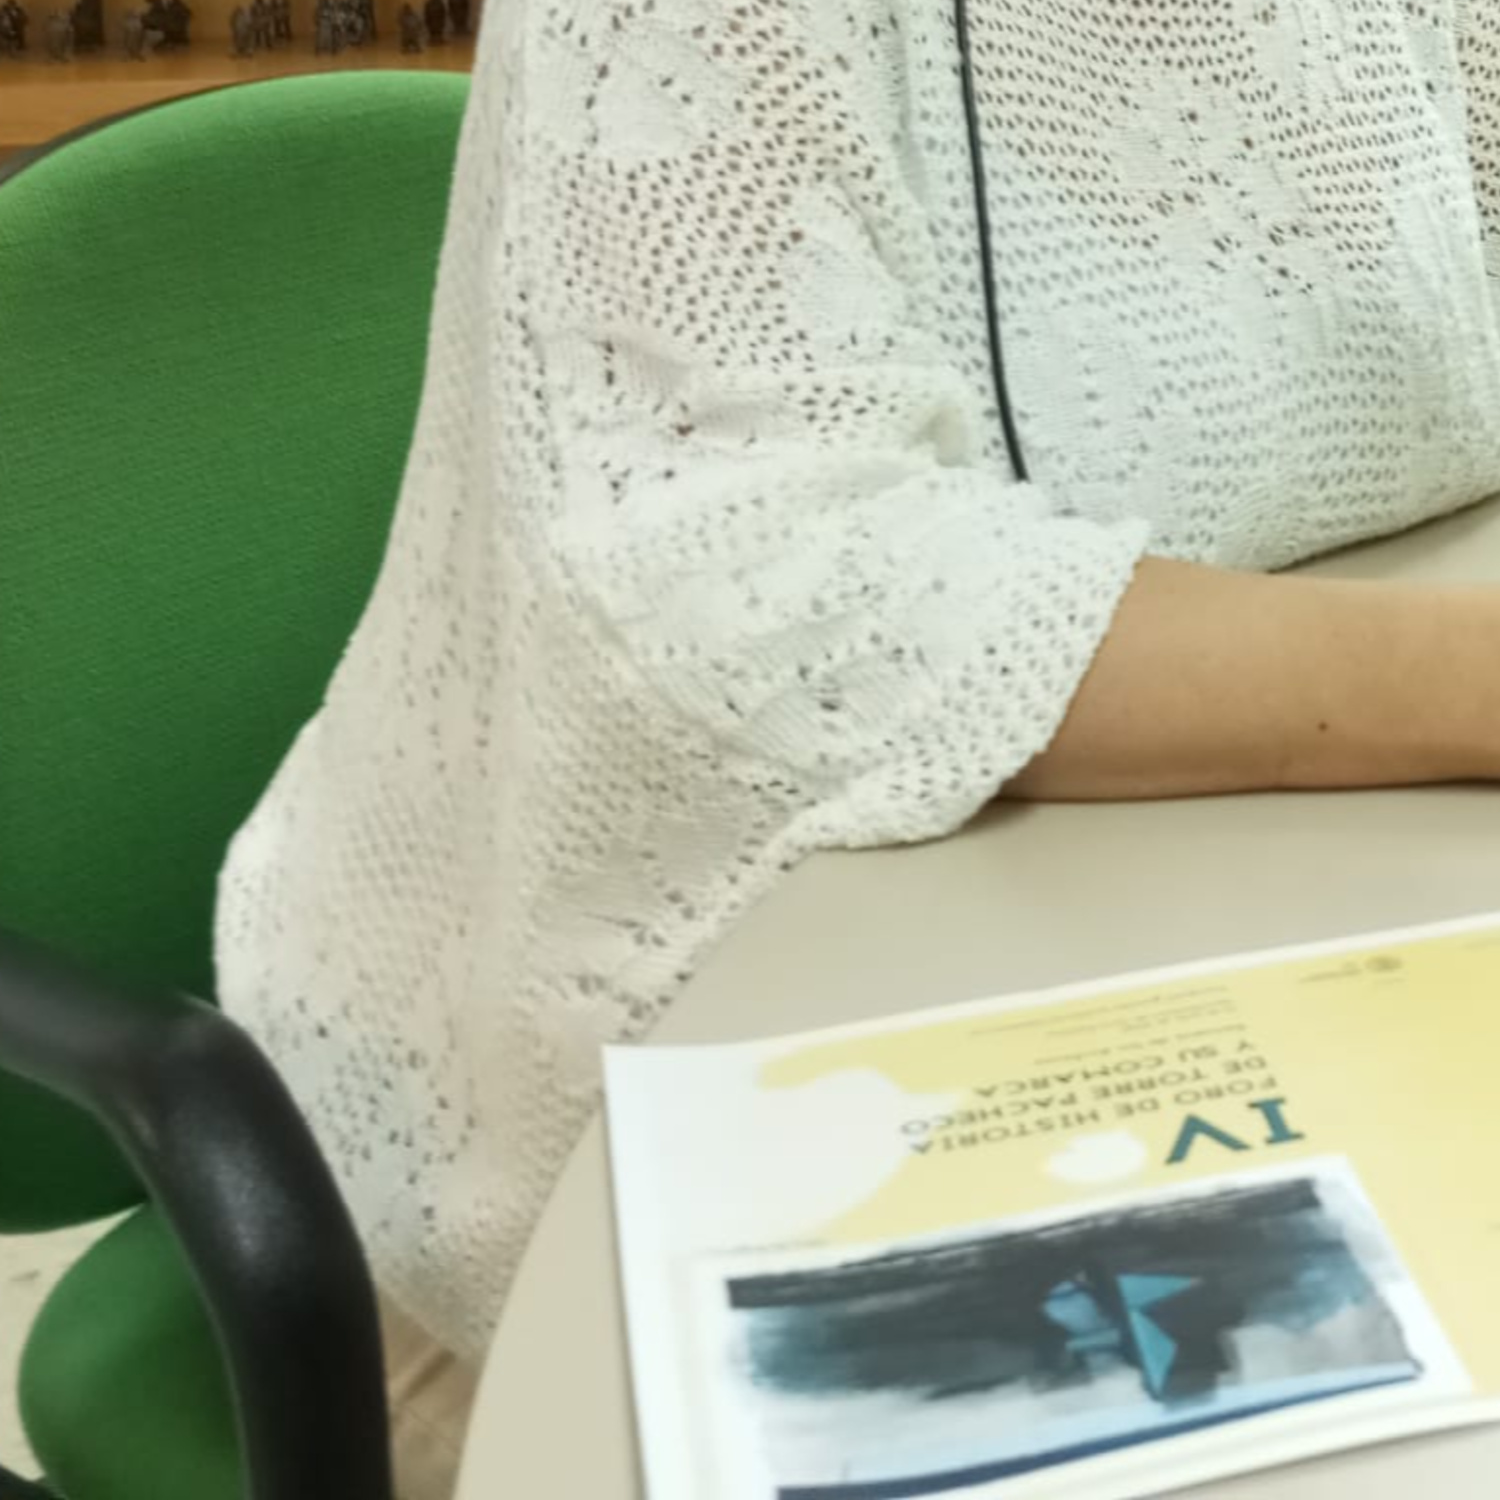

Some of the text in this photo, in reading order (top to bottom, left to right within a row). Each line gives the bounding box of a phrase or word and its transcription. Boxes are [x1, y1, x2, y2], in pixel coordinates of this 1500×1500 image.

[1177, 1045, 1219, 1063] SU
[1236, 1040, 1256, 1053] Y
[900, 1056, 1267, 1136] DE TORRE PACHECO
[972, 1055, 1165, 1099] COMARCA
[909, 1075, 1278, 1155] FORO DE HISTORIA
[1164, 1097, 1305, 1165] IV
